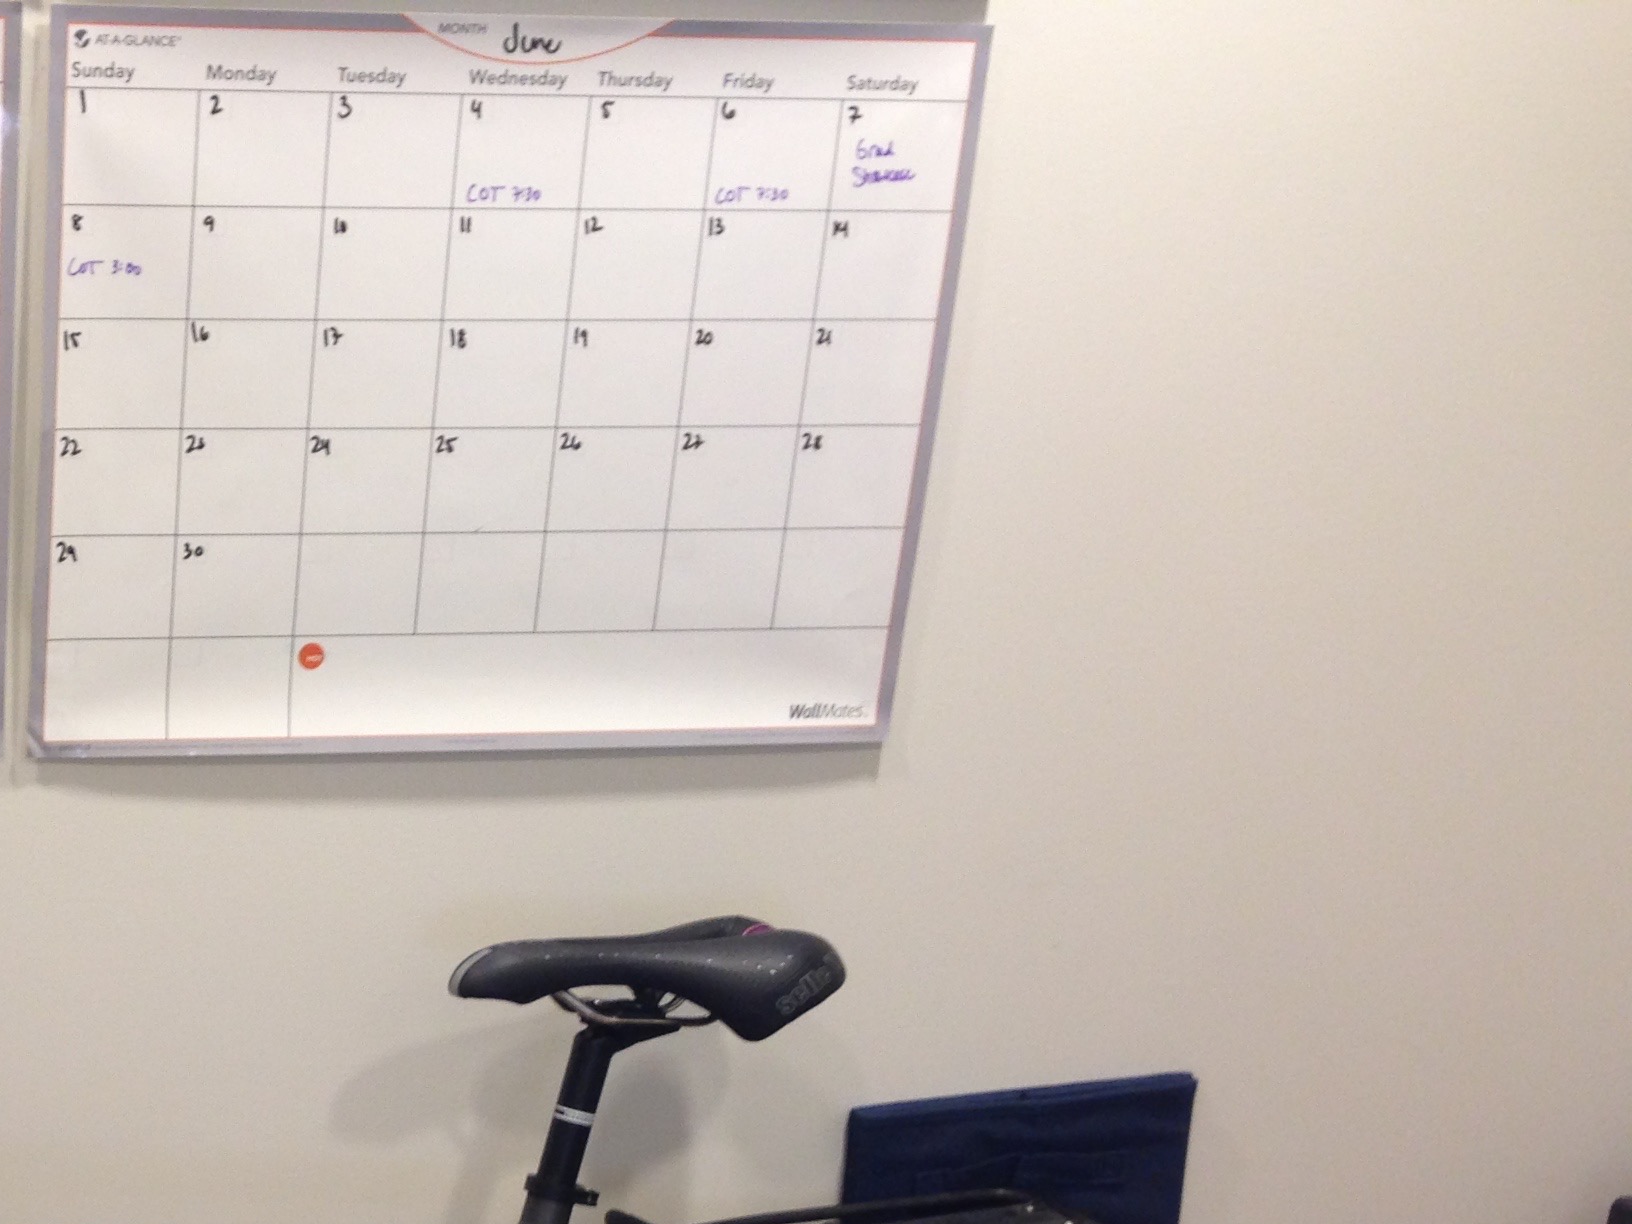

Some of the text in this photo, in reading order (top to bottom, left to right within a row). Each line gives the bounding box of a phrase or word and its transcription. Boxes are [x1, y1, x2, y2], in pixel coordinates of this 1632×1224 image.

[437, 22, 487, 35] MONTH
[502, 22, 563, 55] June
[71, 61, 919, 95] Sunday Monday Tuesday Wednesday Thursday Friday Saturday
[79, 91, 88, 114] 1
[210, 95, 224, 115] 2
[337, 96, 354, 118] 3
[469, 100, 483, 119] 4
[600, 101, 616, 120] 5
[720, 101, 737, 120] 6
[848, 105, 864, 125] 7
[71, 214, 84, 233] 8
[202, 215, 216, 235] 9
[333, 216, 349, 236] 10
[460, 216, 473, 235] 11
[583, 216, 605, 236] 12
[707, 217, 726, 237] 13
[831, 219, 850, 239] 14
[62, 330, 82, 352] 15
[191, 321, 211, 344] 16
[322, 327, 345, 348] 17
[450, 327, 468, 350] 18
[572, 327, 590, 348] 19
[694, 328, 714, 347] 20
[815, 328, 834, 347] 21
[59, 436, 83, 457] 22
[309, 435, 332, 456] 24
[434, 435, 459, 455] 25
[559, 432, 583, 452] 26
[682, 432, 706, 452] 27
[802, 432, 825, 452] 28
[57, 541, 79, 564] 29
[182, 541, 206, 561] 30
[787, 703, 864, 721] WallMates
